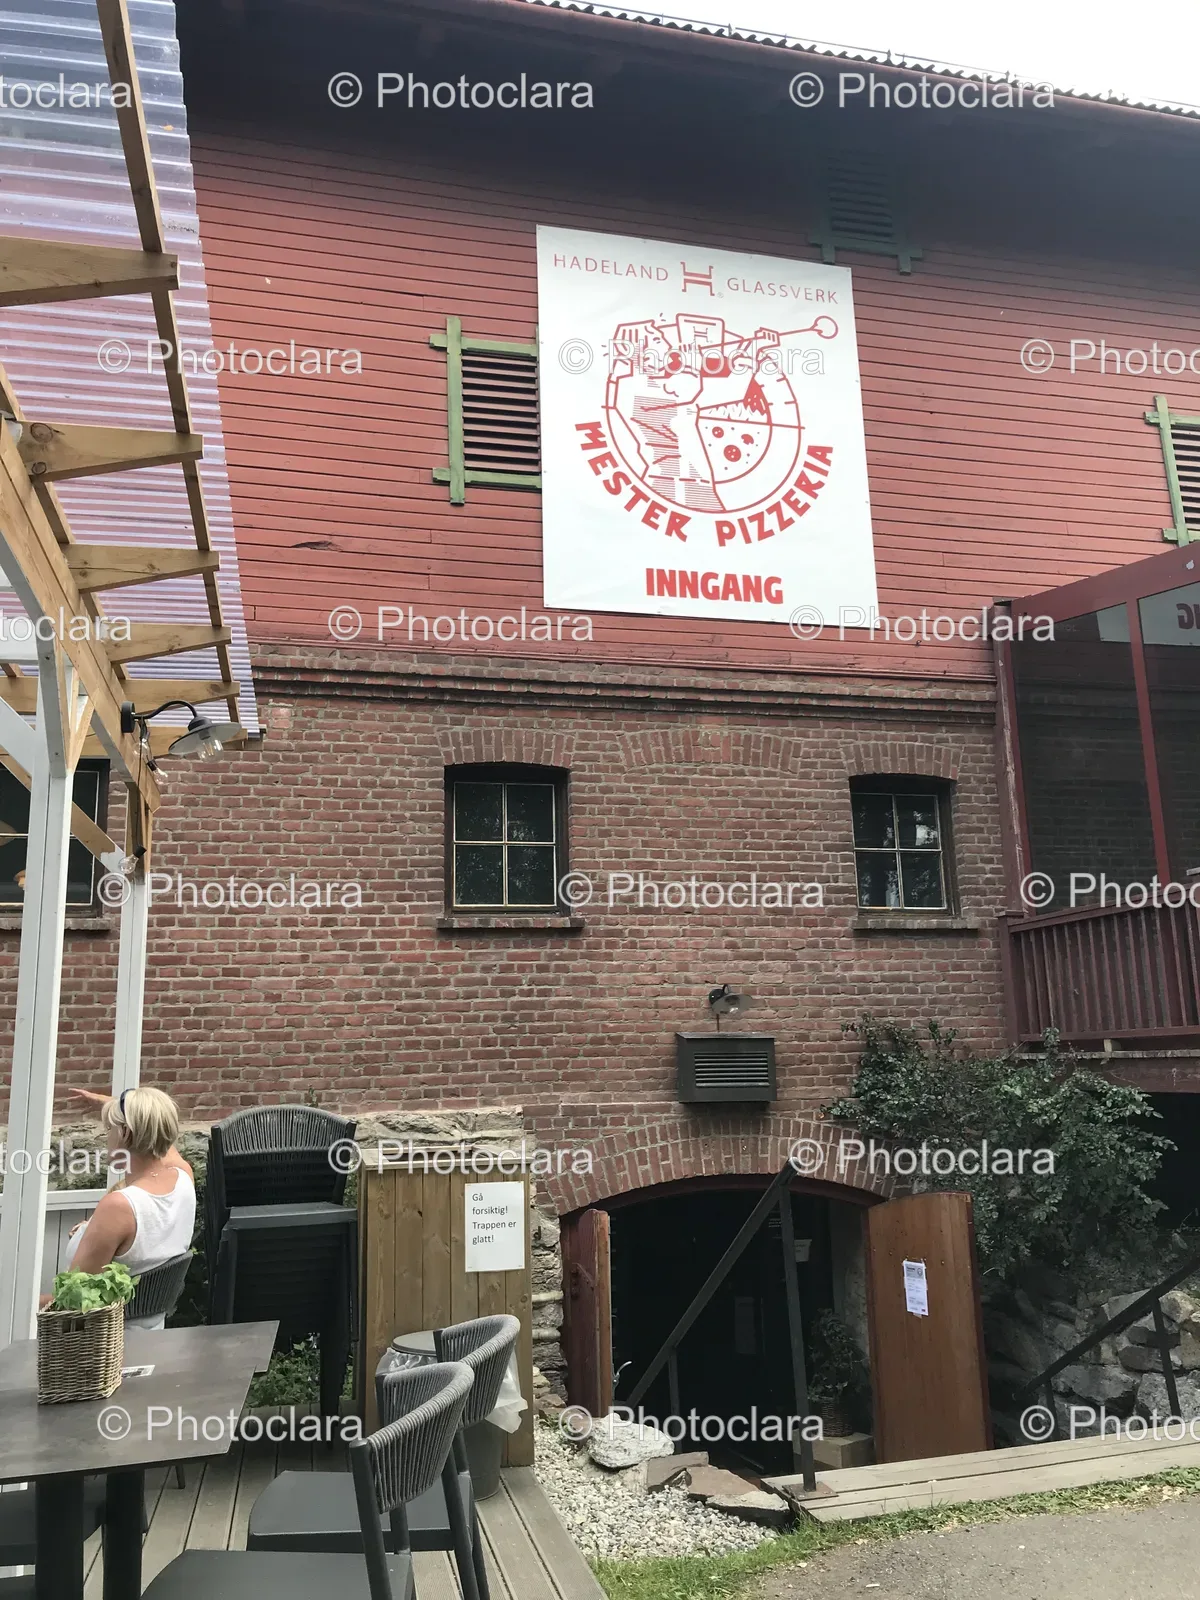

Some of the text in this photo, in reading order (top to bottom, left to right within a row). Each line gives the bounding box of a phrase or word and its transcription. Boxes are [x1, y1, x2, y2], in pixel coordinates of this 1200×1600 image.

[554, 253, 669, 281] HADELAND
[727, 277, 838, 304] GLASSVERK
[575, 421, 834, 547] MESTER PIZZERIA
[646, 567, 784, 604] INNGANG
[472, 1192, 484, 1201] Gå
[472, 1205, 508, 1216] forsiktig!
[472, 1221, 506, 1230] Trappen
[472, 1234, 494, 1246] glatt!
